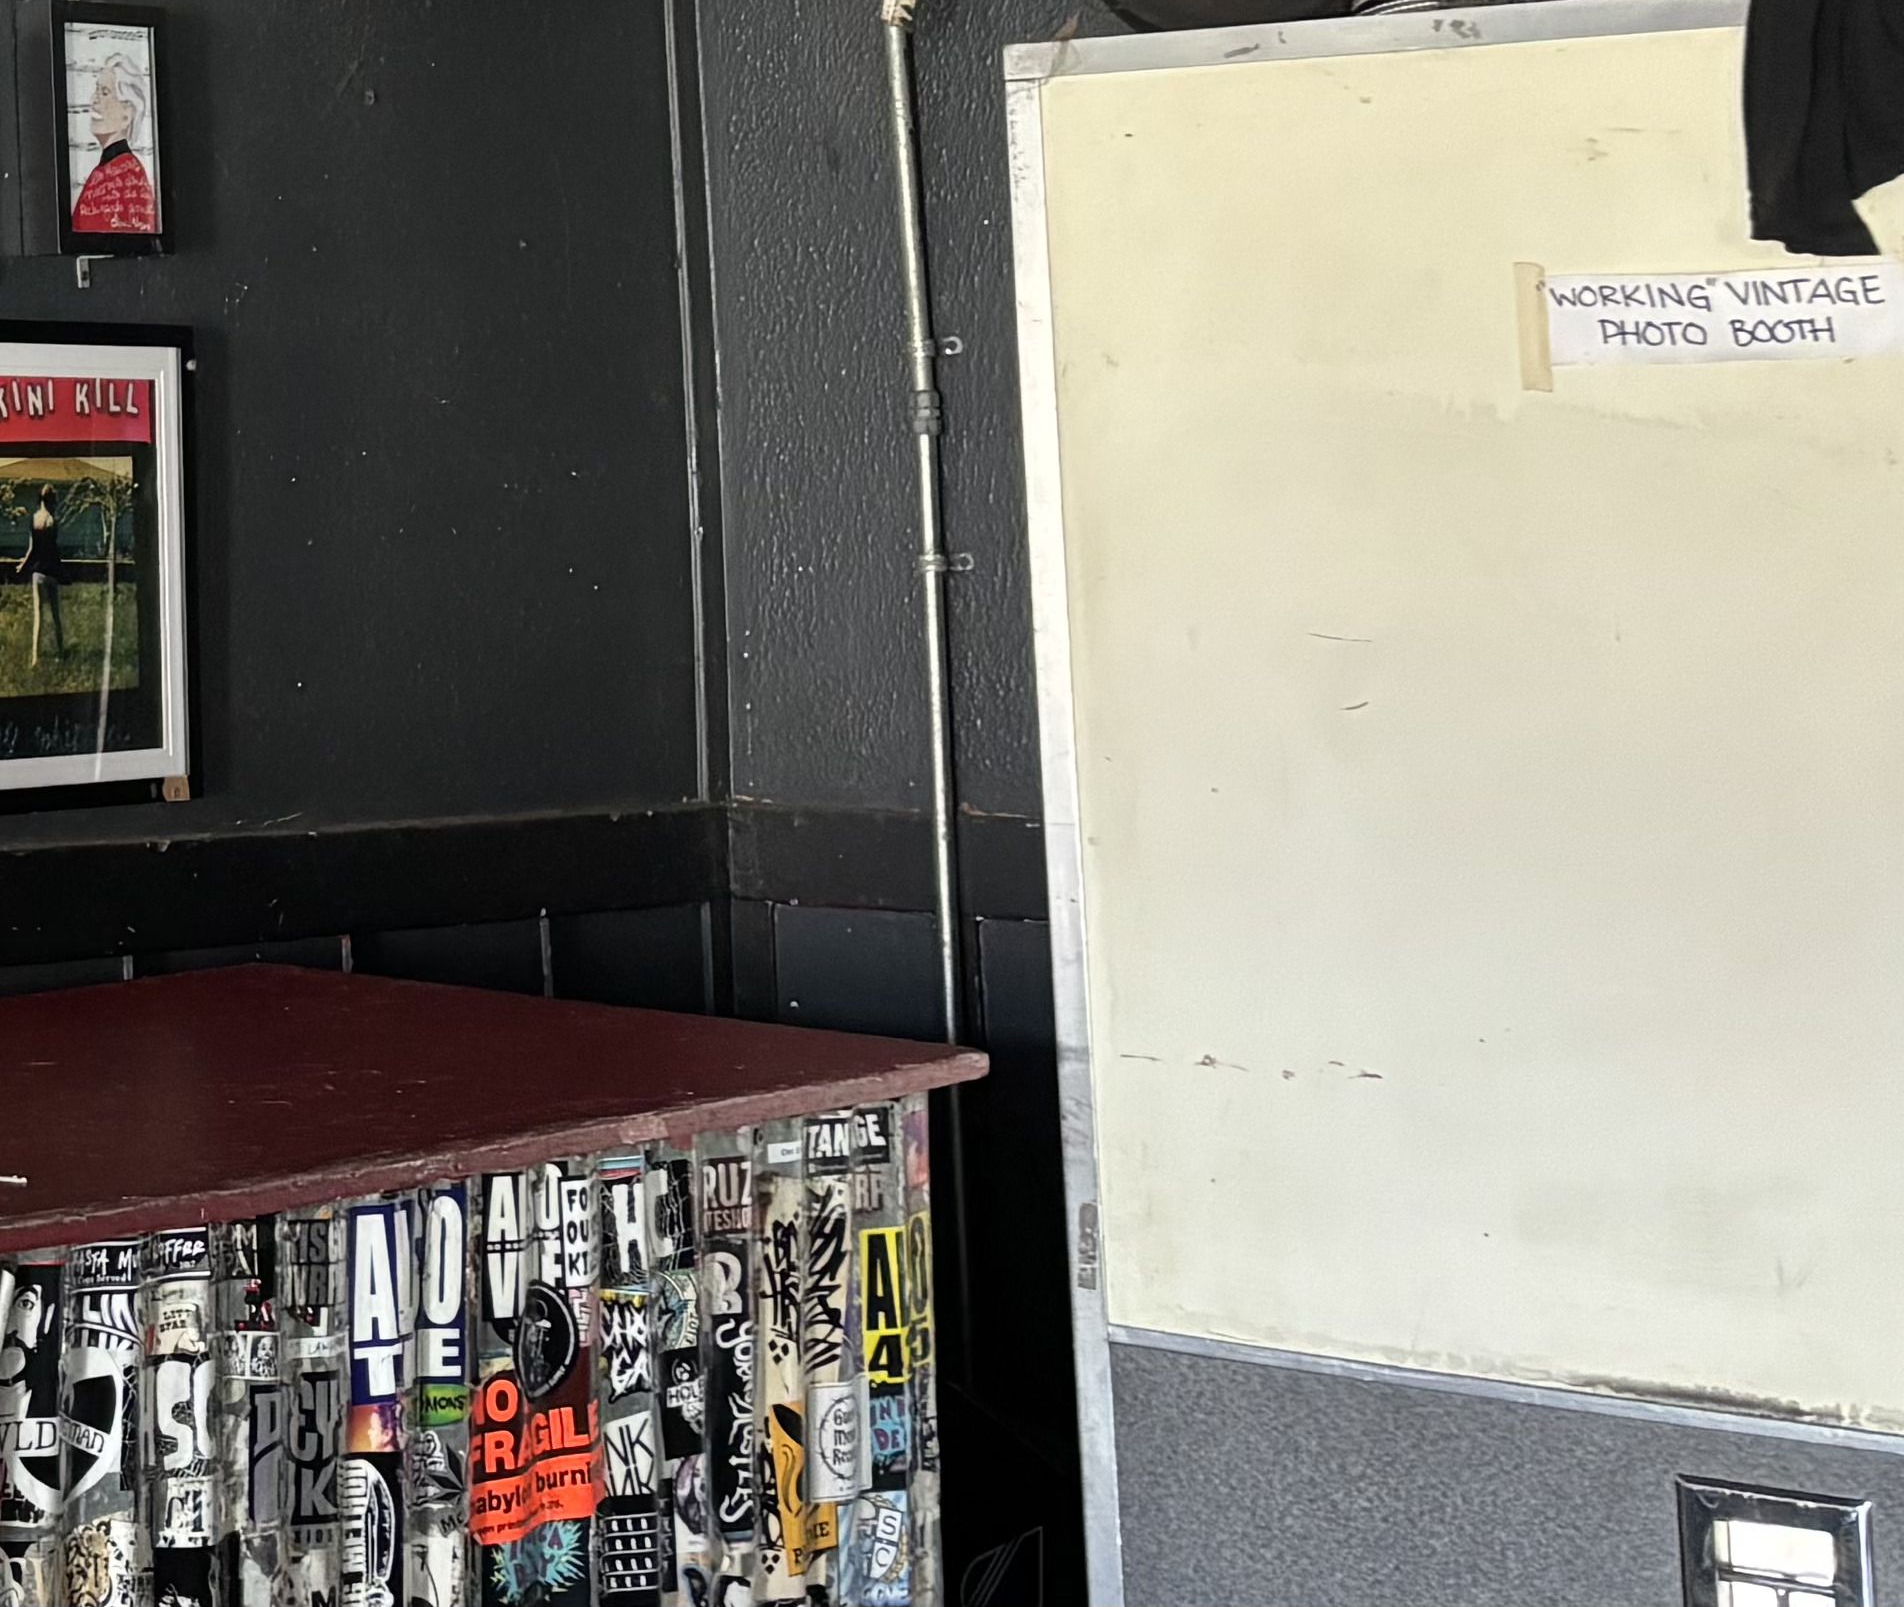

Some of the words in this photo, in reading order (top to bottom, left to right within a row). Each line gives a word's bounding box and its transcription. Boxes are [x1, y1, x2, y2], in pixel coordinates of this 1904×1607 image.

[1724, 275, 1885, 305] VINTAGE
[1598, 319, 1707, 346] PHOTO
[1731, 317, 1835, 347] BOOTH
[75, 378, 139, 414] KILL
